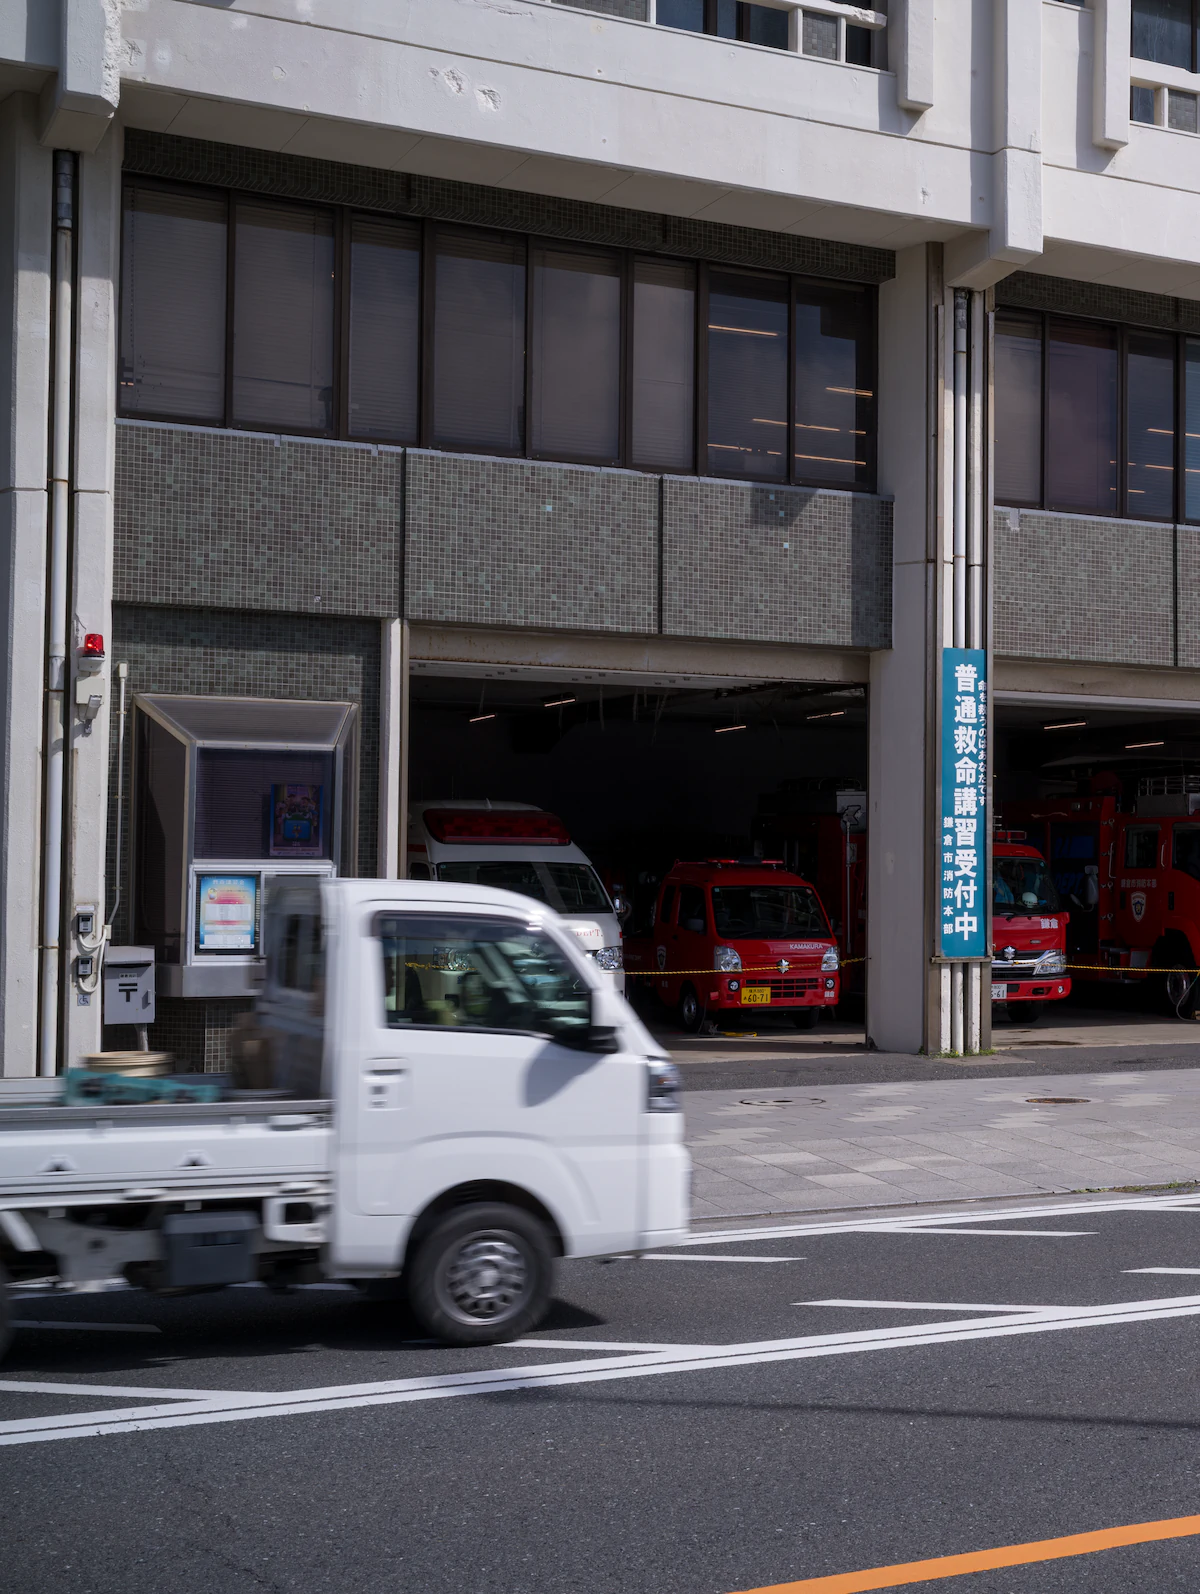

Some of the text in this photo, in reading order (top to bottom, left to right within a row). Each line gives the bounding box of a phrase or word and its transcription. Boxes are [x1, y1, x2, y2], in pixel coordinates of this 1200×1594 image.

[943, 816, 954, 935] 鎌倉市消防本部
[954, 664, 979, 941] 普通救命講習受付中
